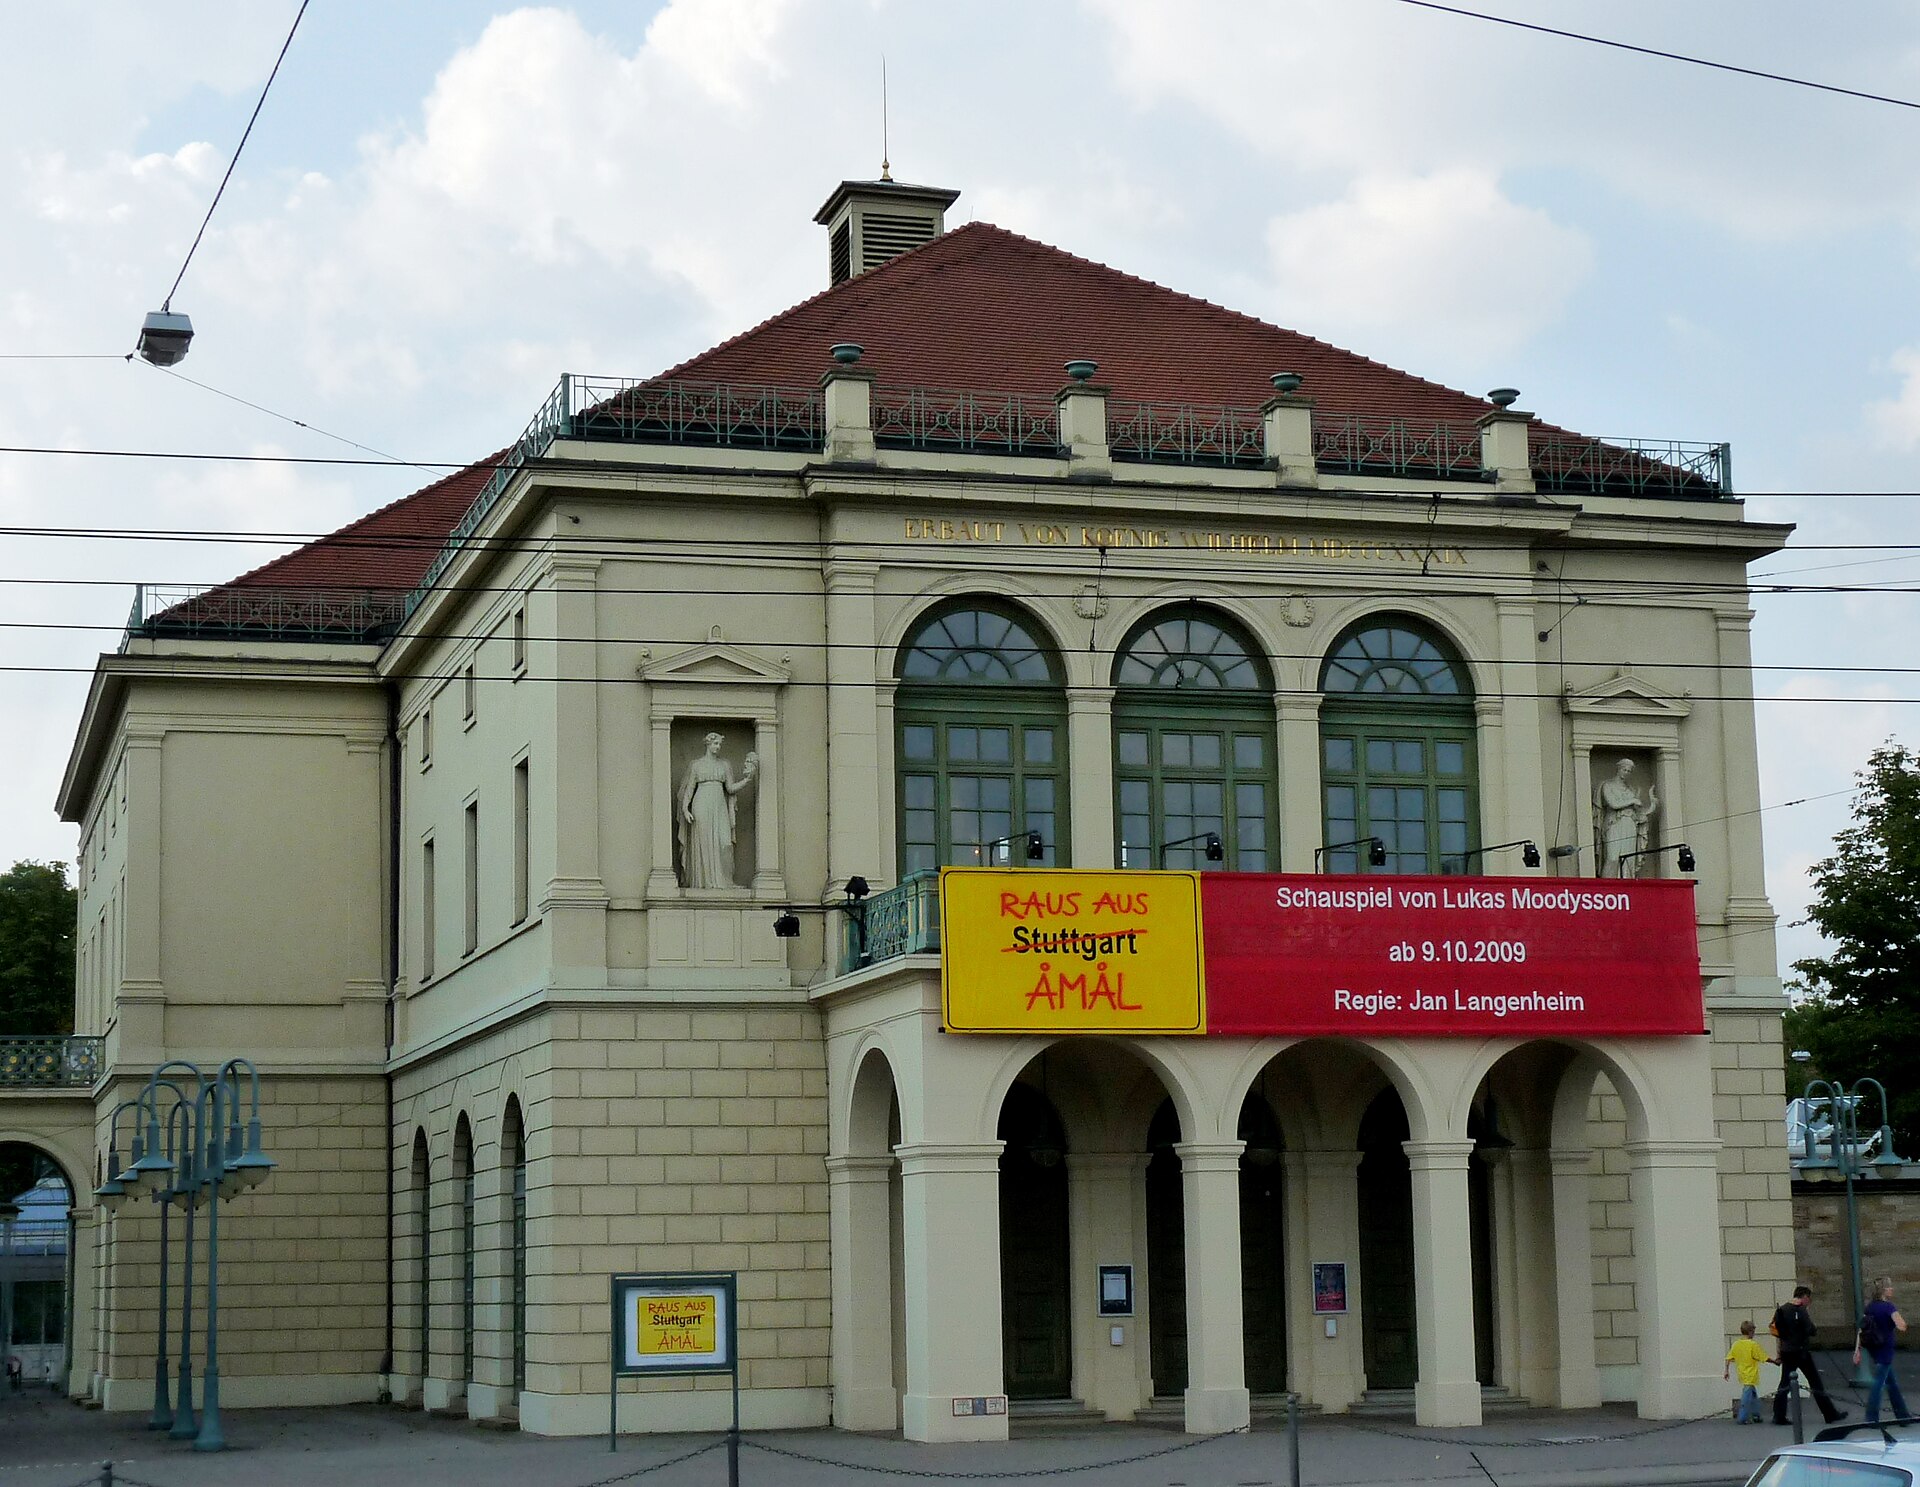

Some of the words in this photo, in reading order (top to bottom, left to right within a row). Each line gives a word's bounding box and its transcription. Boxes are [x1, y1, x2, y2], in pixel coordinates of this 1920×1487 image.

[904, 518, 1005, 542] ERBAUT
[1018, 523, 1069, 545] VON
[1081, 526, 1169, 548] KOENIG
[1000, 891, 1082, 919] RAUS
[1092, 892, 1149, 915] AUS
[1276, 887, 1393, 912] Schauspiel
[1399, 891, 1437, 908] von
[1443, 888, 1506, 909] Lukas
[1512, 888, 1630, 914] Moodysson
[1012, 926, 1138, 961] Stuttgart
[1389, 941, 1416, 962] ab
[1422, 940, 1526, 963] 9.10.2009
[1025, 962, 1143, 1011] ÅMÅL
[1334, 989, 1402, 1016] Regie:
[1409, 989, 1447, 1010] Jan
[1454, 989, 1584, 1017] Langenheim
[648, 1302, 680, 1314] RAUS
[684, 1301, 706, 1312] AUS
[653, 1314, 702, 1328] Stuttgart
[657, 1330, 703, 1350] ÅMÅL
